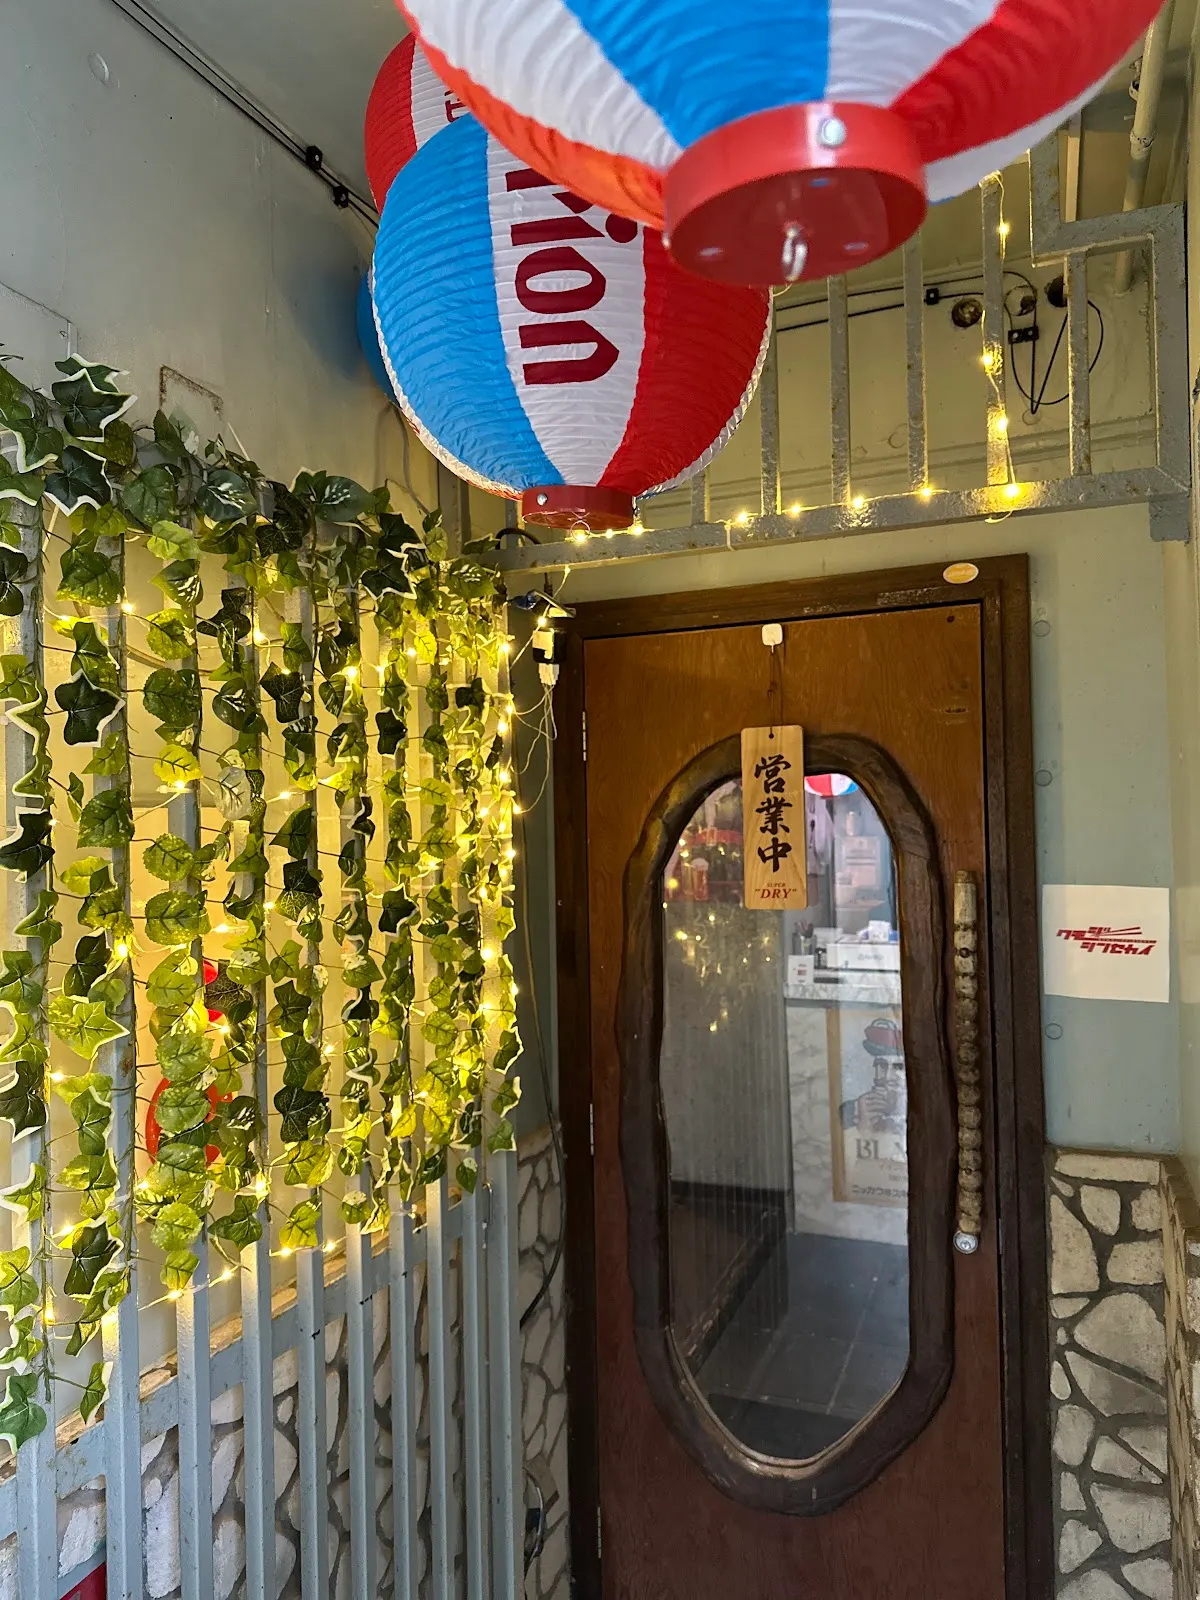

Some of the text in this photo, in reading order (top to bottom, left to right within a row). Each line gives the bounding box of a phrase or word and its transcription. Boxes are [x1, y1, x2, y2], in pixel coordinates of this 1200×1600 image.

[505, 168, 638, 385] rion
[753, 753, 793, 873] 営業中
